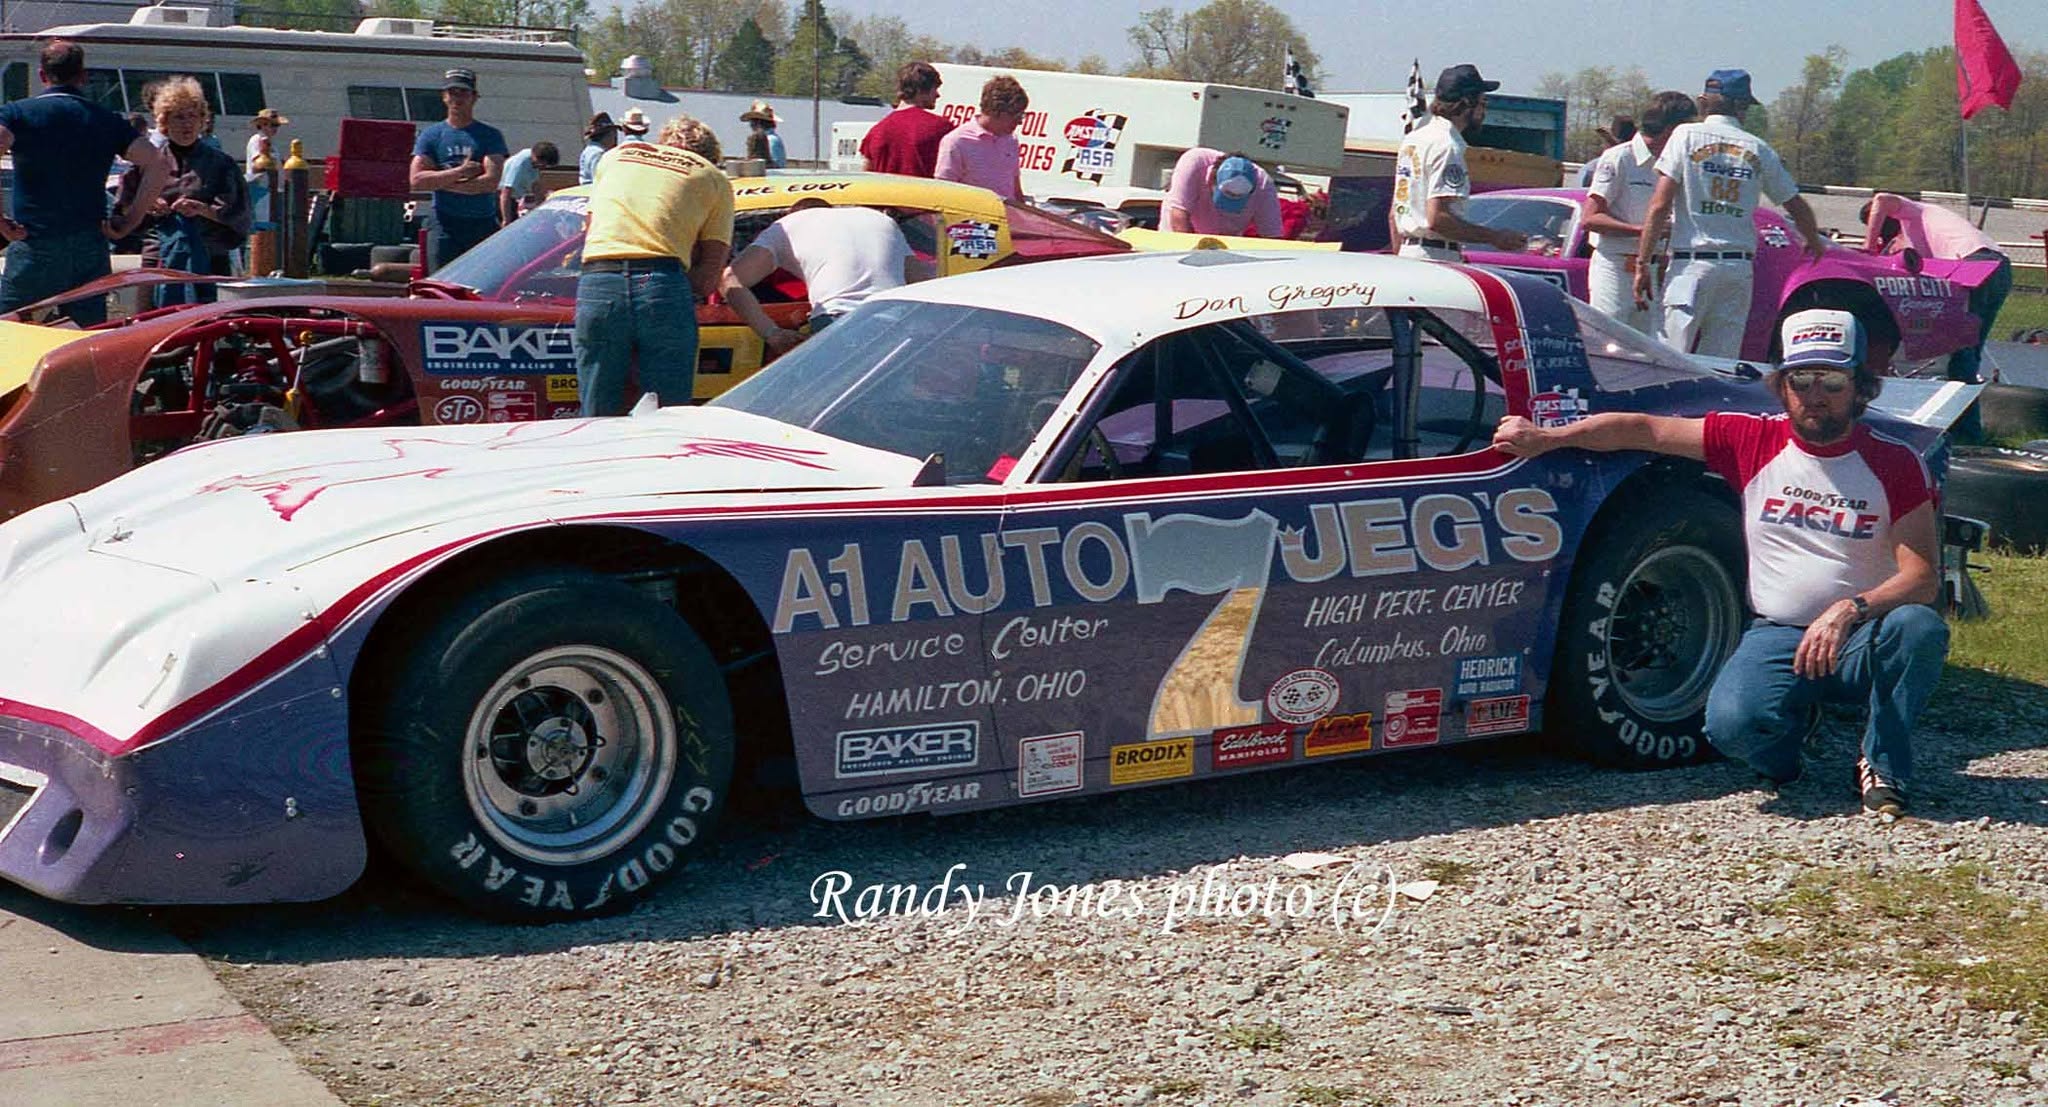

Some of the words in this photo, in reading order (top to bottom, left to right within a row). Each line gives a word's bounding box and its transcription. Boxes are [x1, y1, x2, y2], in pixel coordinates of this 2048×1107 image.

[1021, 111, 1049, 138] OIL
[1080, 148, 1114, 168] ASA
[736, 185, 774, 197] IKE
[787, 181, 851, 194] EDDY
[1173, 295, 1249, 320] Don
[1267, 282, 1377, 310] Gregory
[1874, 276, 1917, 297] PORT
[1919, 277, 1952, 298] CITY
[1792, 332, 1843, 345] EAGLE
[551, 379, 578, 389] BRO
[441, 399, 475, 421] STP
[1759, 498, 1880, 539] EAGLE
[1276, 487, 1563, 583] JEG'S
[891, 521, 1129, 622] AUTO
[1304, 593, 1365, 628] HIGH
[1373, 588, 1436, 620] PERF.
[1442, 577, 1525, 613] CENTER
[1123, 507, 1279, 741] 7
[815, 633, 964, 675] Service
[1440, 625, 1488, 656] Ohio
[1460, 657, 1518, 680] HEDRICK
[1017, 670, 1086, 702] OHIO
[842, 728, 973, 762] BAKER
[1220, 729, 1287, 751] Edelbrock
[1116, 744, 1188, 766] BRODIX
